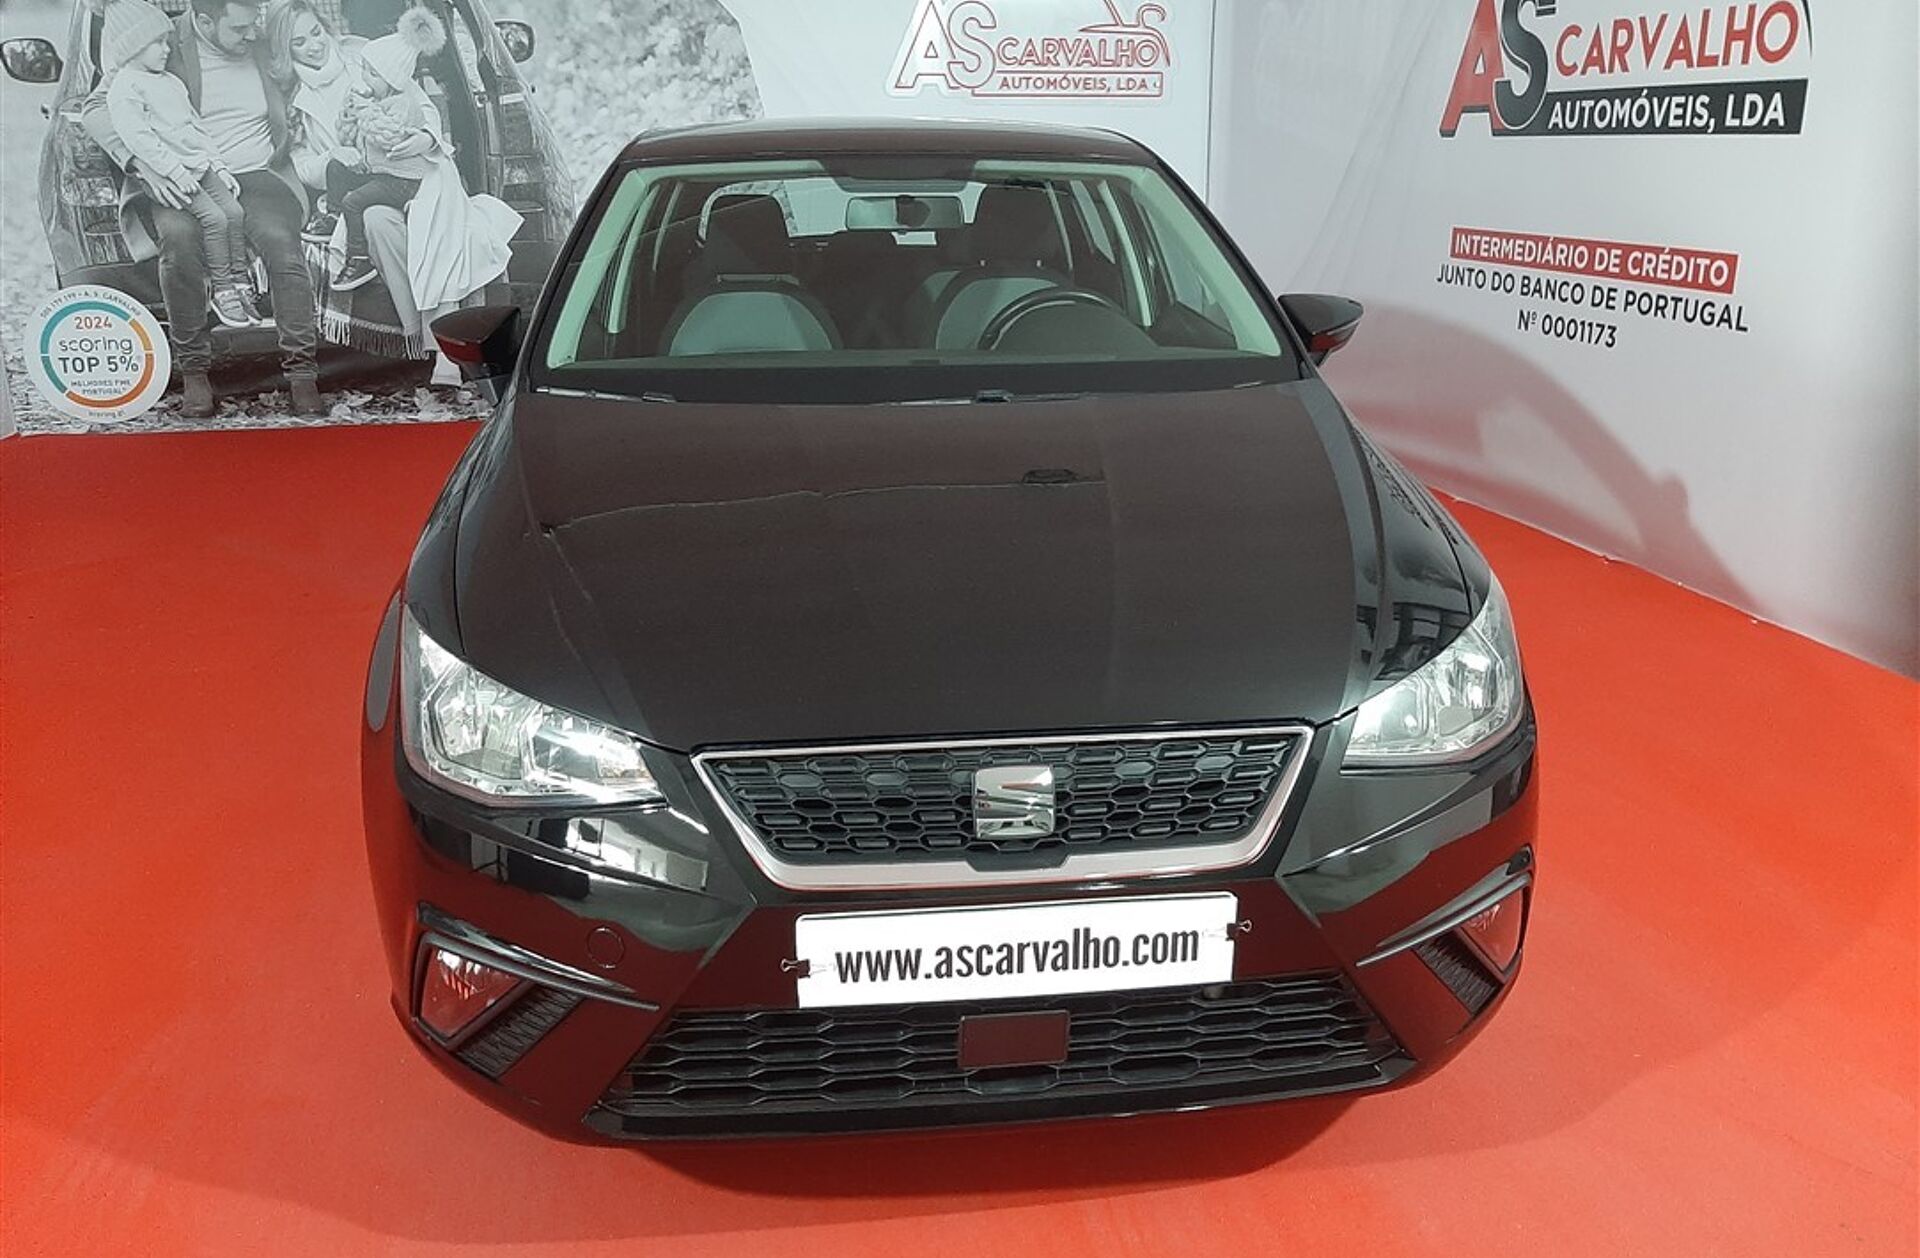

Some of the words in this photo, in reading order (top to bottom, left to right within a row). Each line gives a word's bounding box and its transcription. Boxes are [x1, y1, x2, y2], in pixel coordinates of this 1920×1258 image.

[997, 38, 1159, 67] CARVALHO
[1556, 0, 1799, 77] CARVALHO
[1000, 73, 1111, 93] AUTOMÓVEIS,
[1117, 79, 1147, 91] LDA
[1548, 90, 1716, 133] AUTOMÓVEIS,
[1724, 92, 1786, 128] LDA
[1455, 233, 1589, 269] INTERMEDIÁRIO
[1594, 248, 1621, 273] DE
[1627, 247, 1730, 287] CRÉDITO
[1437, 264, 1487, 289] JUNTO
[1491, 271, 1515, 294] DO
[1520, 275, 1585, 306] BANCO
[1591, 285, 1617, 311] DE
[1624, 290, 1749, 332] PORTUGAL
[74, 316, 112, 330] 2024
[1517, 309, 1538, 331] Nº
[1541, 315, 1618, 348] 0001173
[58, 336, 134, 355] scoring
[58, 356, 100, 374] TOP
[107, 355, 139, 373] 5%
[835, 927, 1200, 984] www.ascarvalho.com
